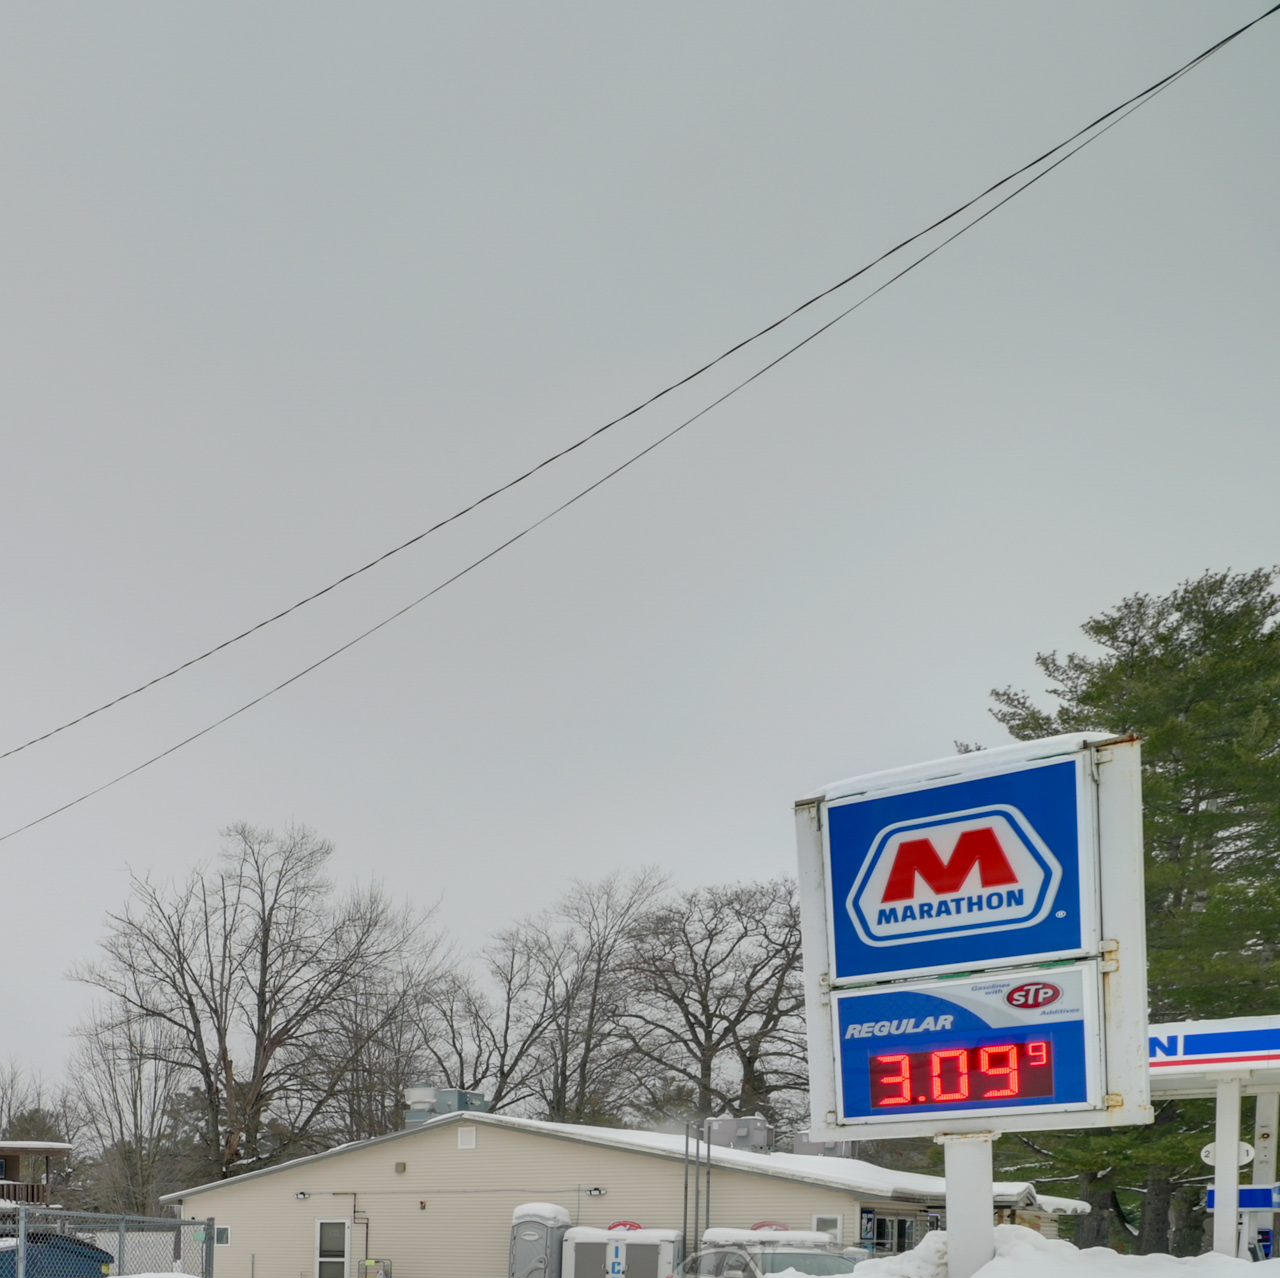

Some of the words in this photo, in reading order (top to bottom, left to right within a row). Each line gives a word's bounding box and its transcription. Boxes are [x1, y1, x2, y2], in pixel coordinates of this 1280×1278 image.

[881, 827, 1019, 903] M
[877, 889, 1024, 925] MARATHON
[971, 983, 1010, 991] Gasolines
[1012, 985, 1054, 1005] STP
[1040, 1008, 1080, 1016] Additives
[845, 1015, 954, 1039] REGULAR
[1204, 1150, 1210, 1158] 2
